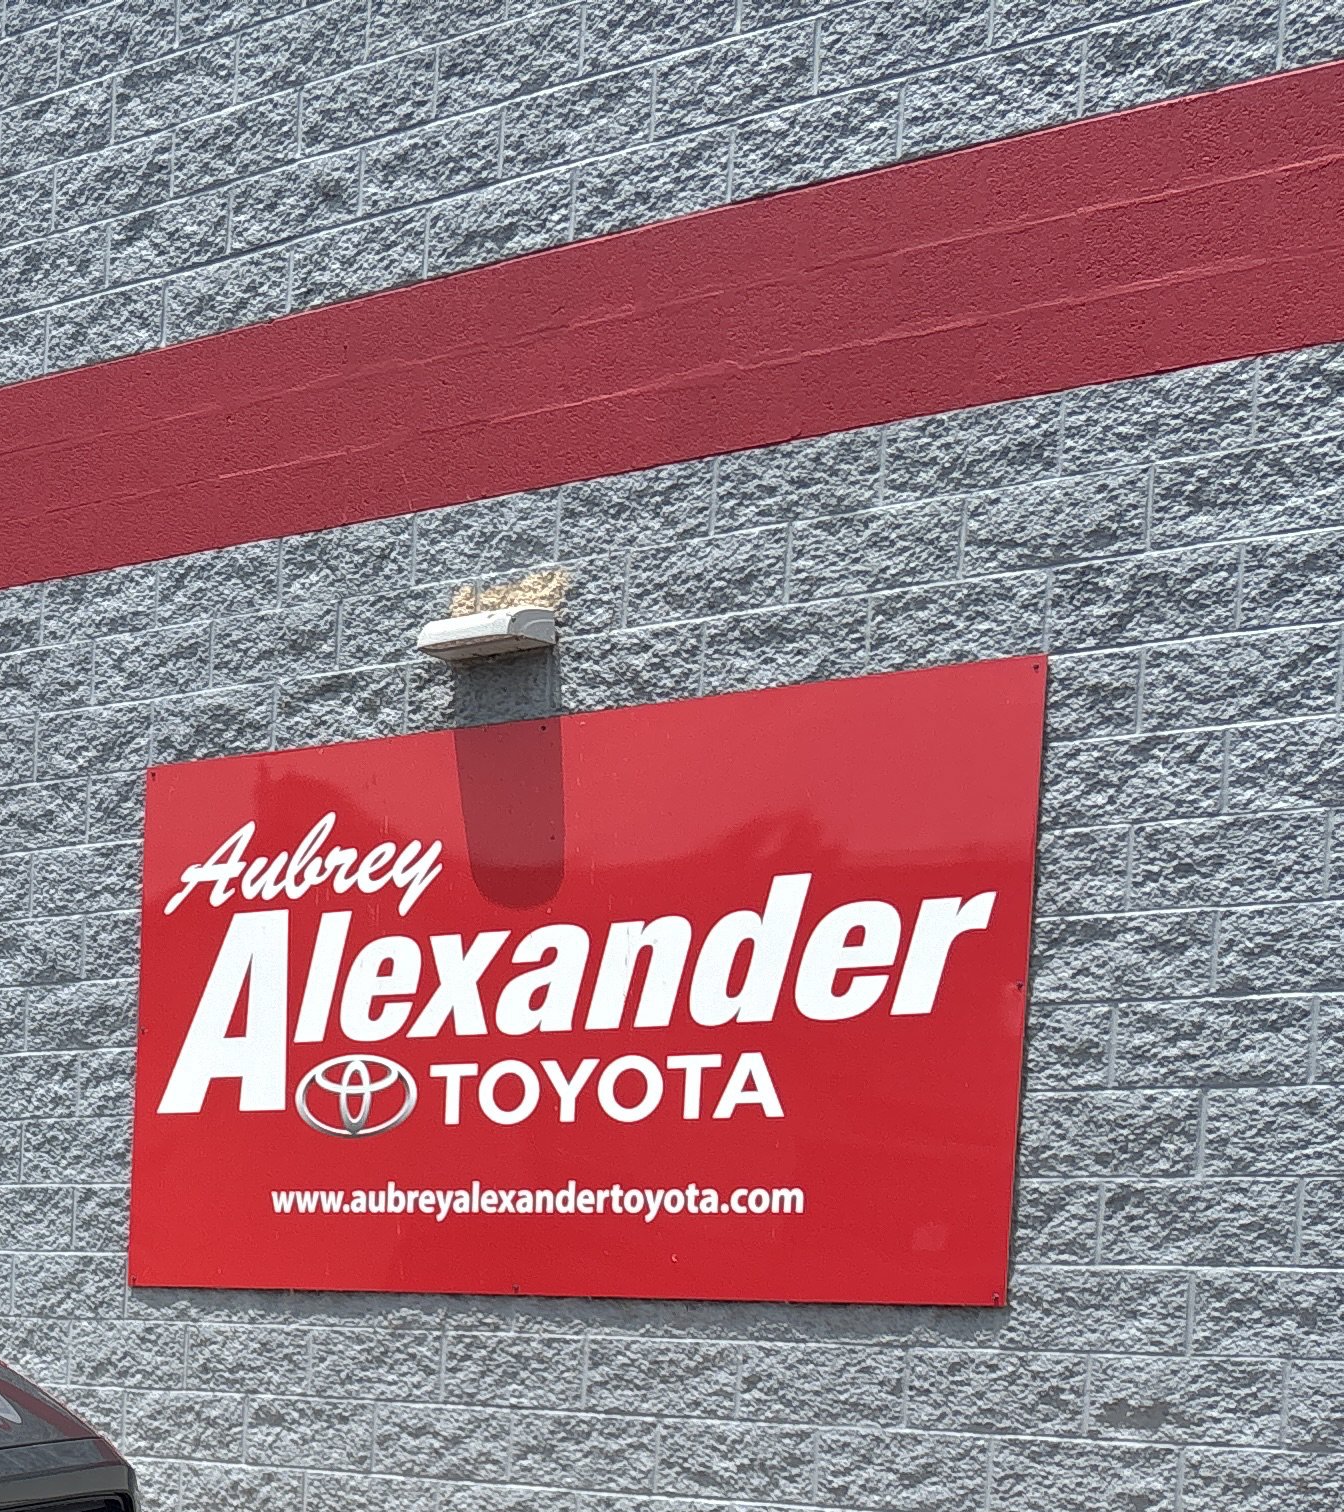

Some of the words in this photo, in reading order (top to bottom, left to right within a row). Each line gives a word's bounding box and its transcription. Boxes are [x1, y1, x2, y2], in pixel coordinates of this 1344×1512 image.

[162, 811, 443, 916] Aubrey
[156, 872, 997, 1114] Alexander
[429, 1052, 785, 1127] TOYOTA
[270, 1179, 806, 1223] www.aubreyalexandertoyota.com
